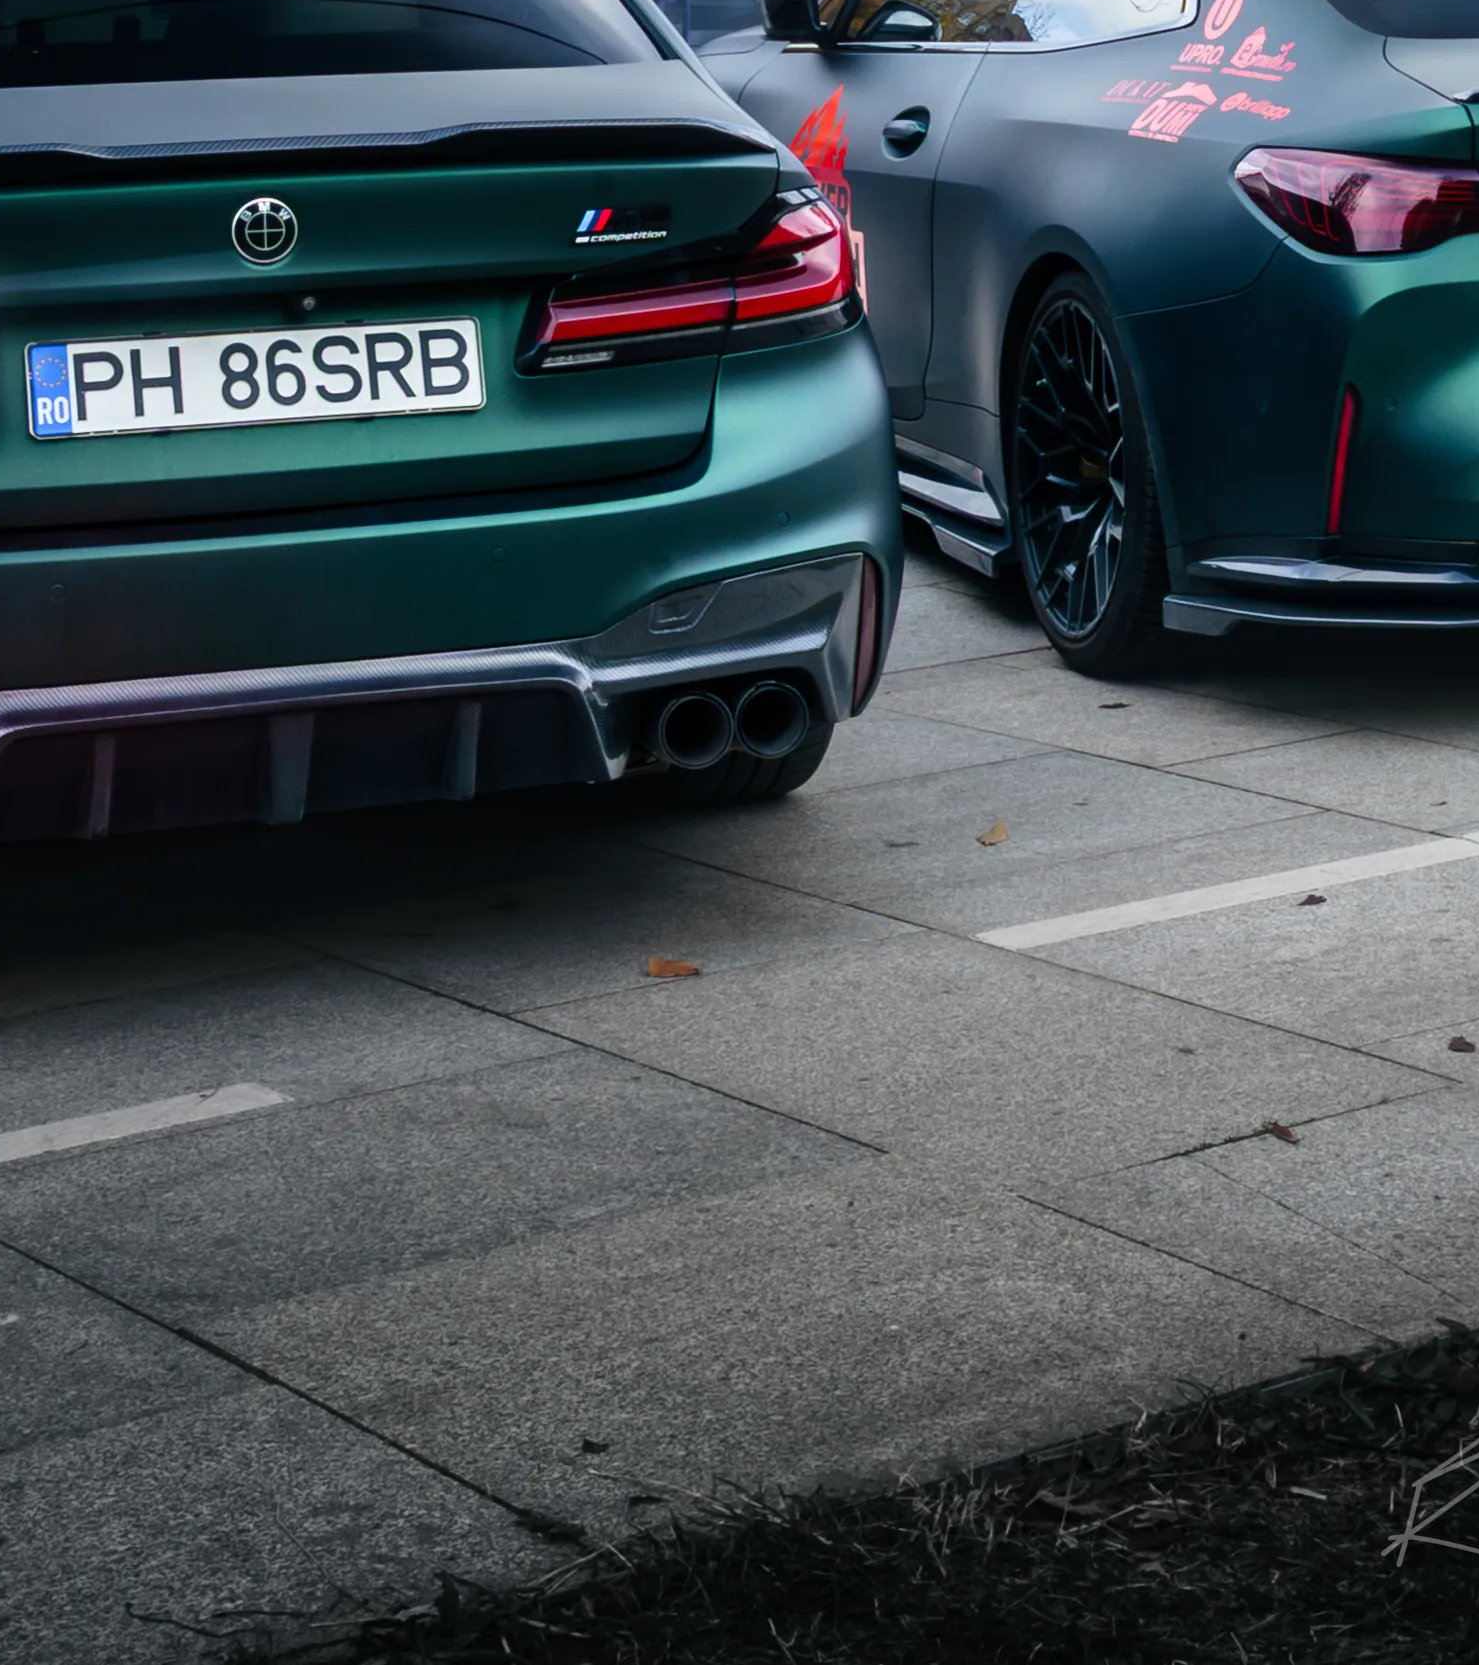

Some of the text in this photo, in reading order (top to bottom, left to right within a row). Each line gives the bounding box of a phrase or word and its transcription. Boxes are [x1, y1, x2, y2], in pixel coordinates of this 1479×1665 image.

[240, 201, 291, 222] BMW
[590, 230, 668, 243] competition
[37, 328, 470, 426] RO PH 86SRB
